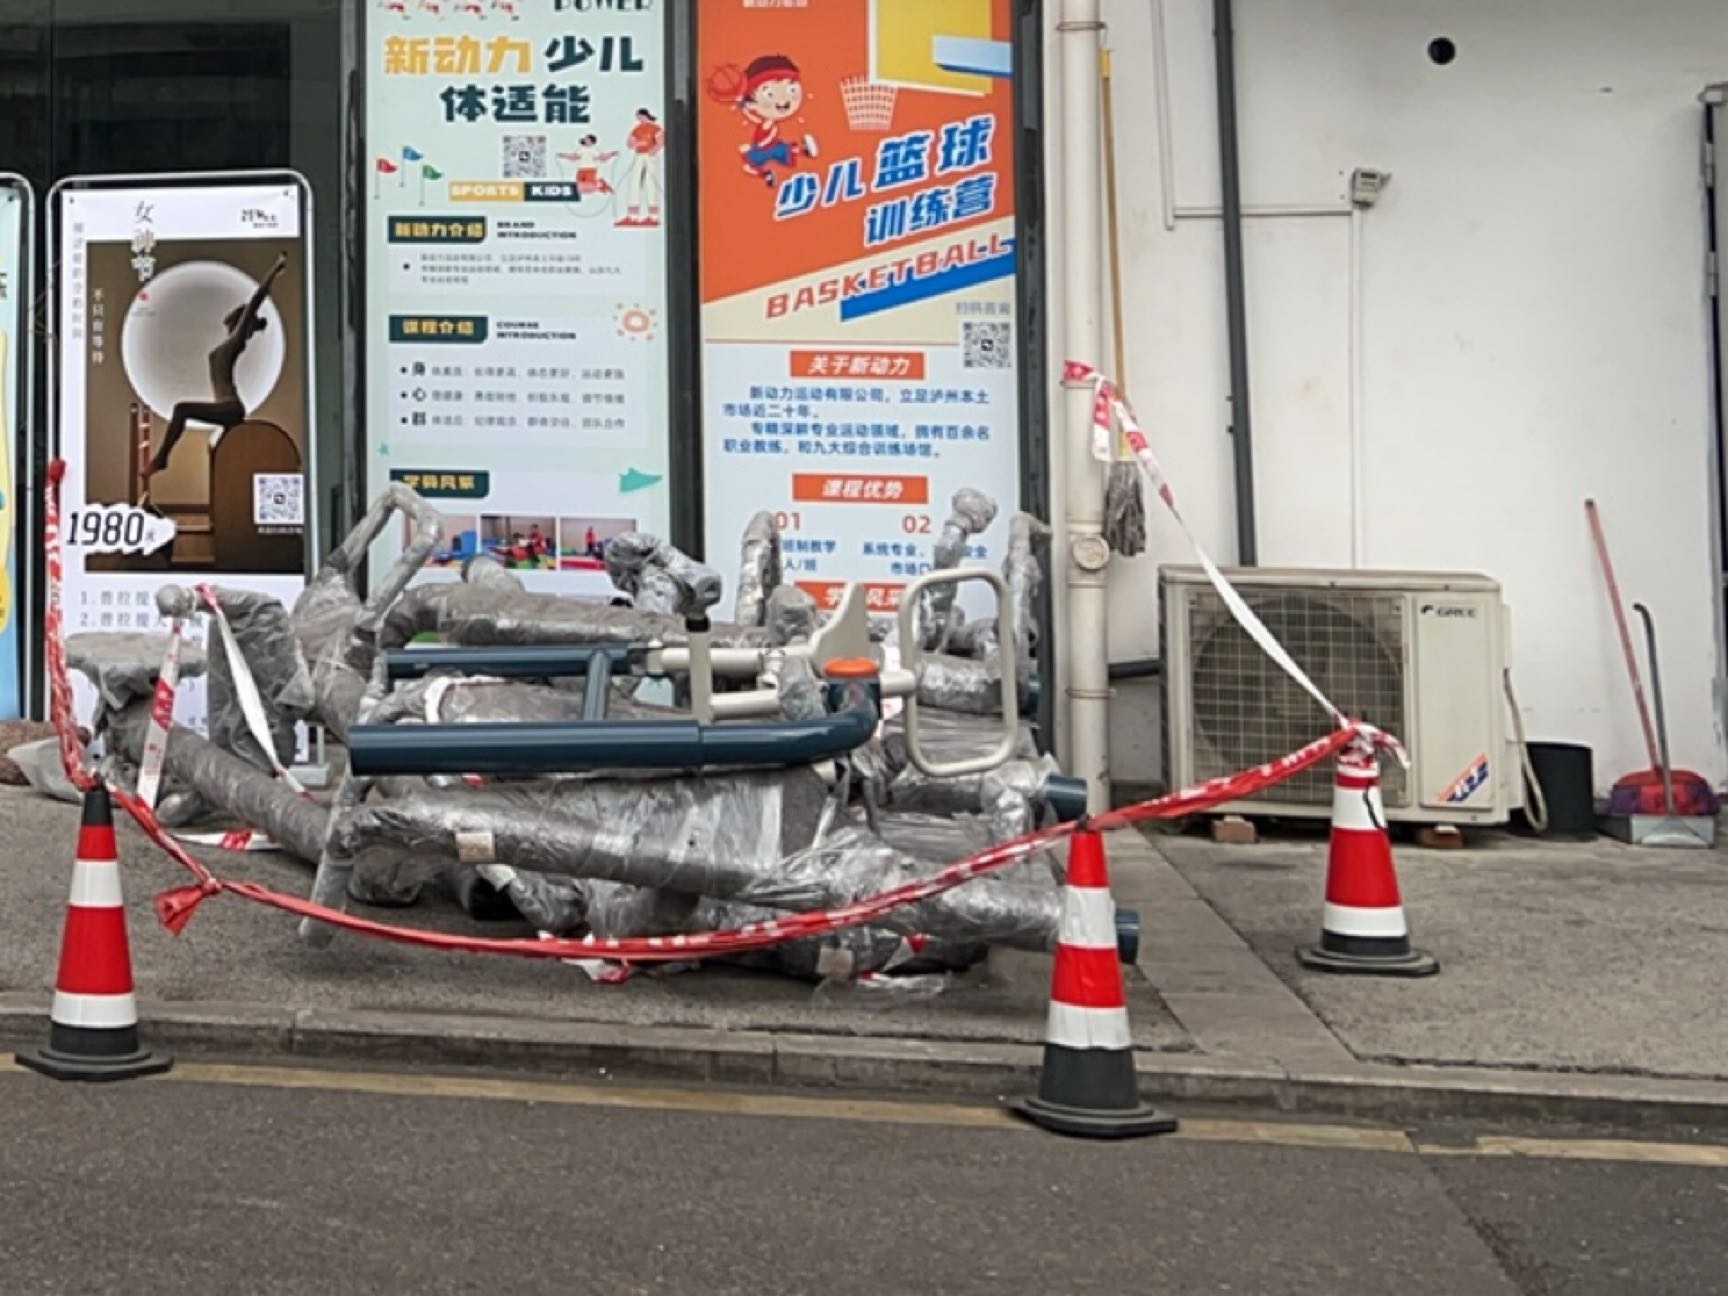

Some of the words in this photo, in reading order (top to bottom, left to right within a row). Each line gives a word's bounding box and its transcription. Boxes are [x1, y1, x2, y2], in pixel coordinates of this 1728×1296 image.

[439, 84, 591, 123] 体适能
[775, 114, 995, 221] 少儿篮球
[531, 185, 572, 197] KIDS
[864, 172, 996, 247] 训练营
[764, 234, 1010, 319] BASKETBALL
[807, 355, 911, 376] 关于新动力
[823, 479, 903, 499] 课程优势
[773, 511, 801, 531] 01
[902, 515, 932, 534] 02
